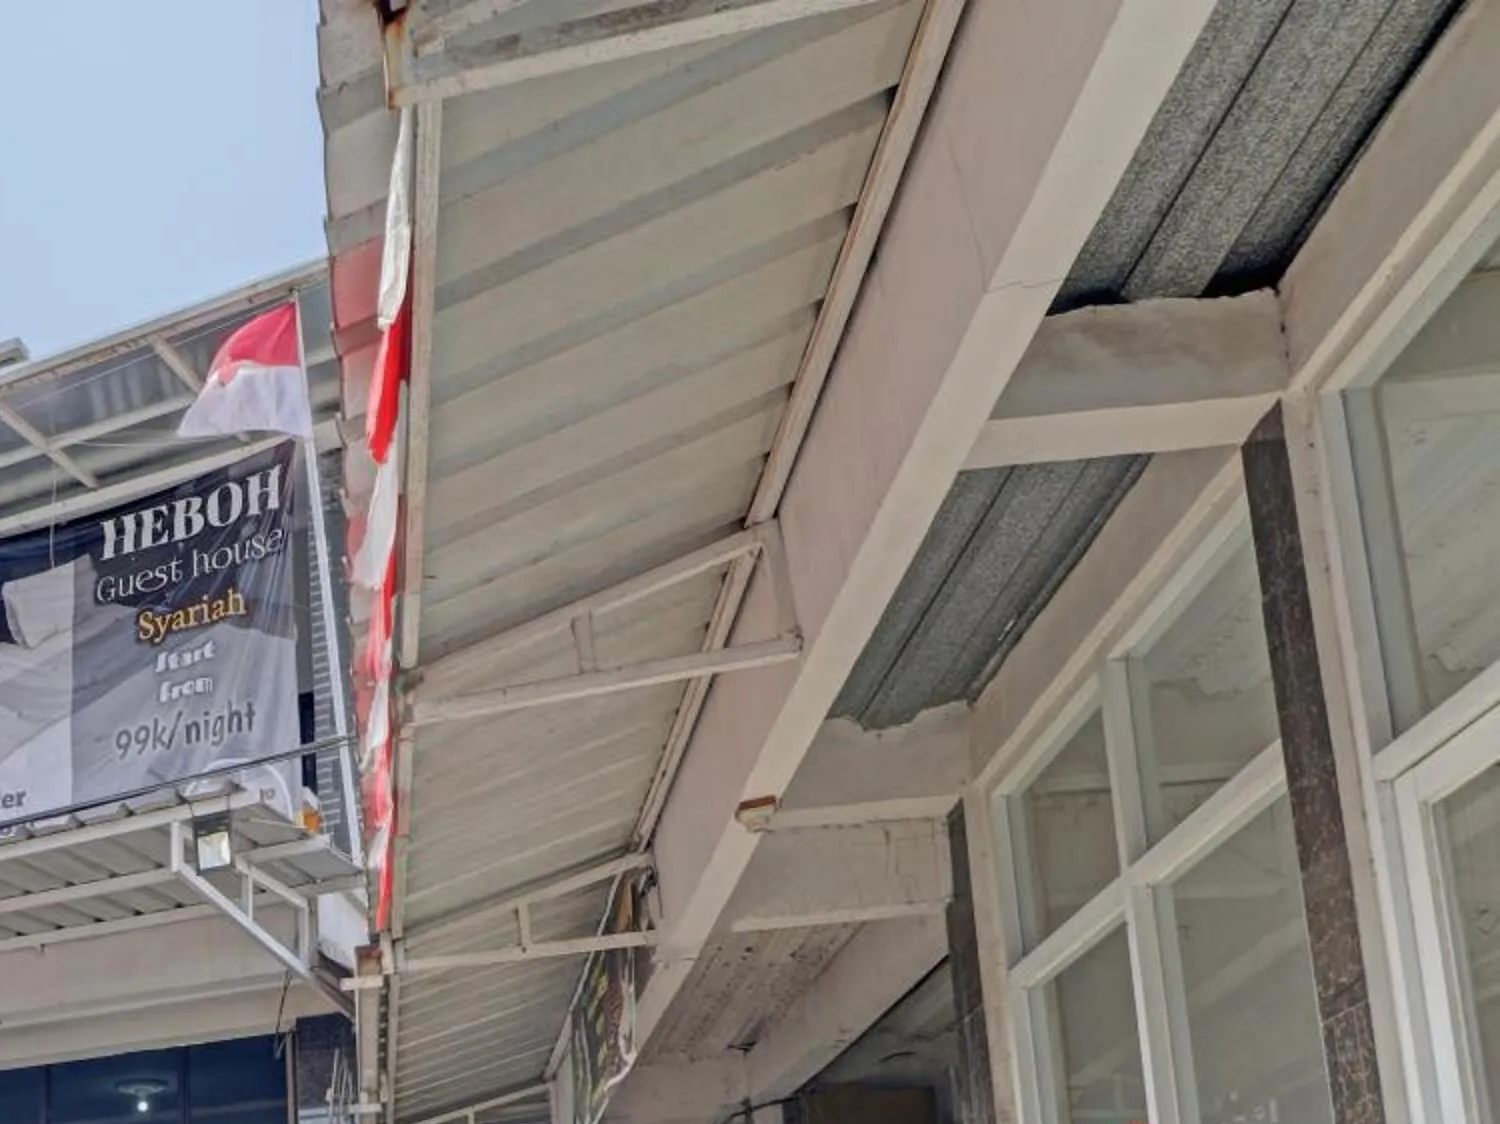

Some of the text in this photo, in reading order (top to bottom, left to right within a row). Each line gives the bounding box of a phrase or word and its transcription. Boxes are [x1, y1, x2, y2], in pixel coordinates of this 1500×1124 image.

[100, 464, 282, 561] HEBOH
[97, 529, 284, 602] Guest house
[137, 586, 248, 641] Syariah
[154, 639, 216, 674] Start
[159, 676, 214, 703] from
[114, 700, 257, 760] 99k/night
